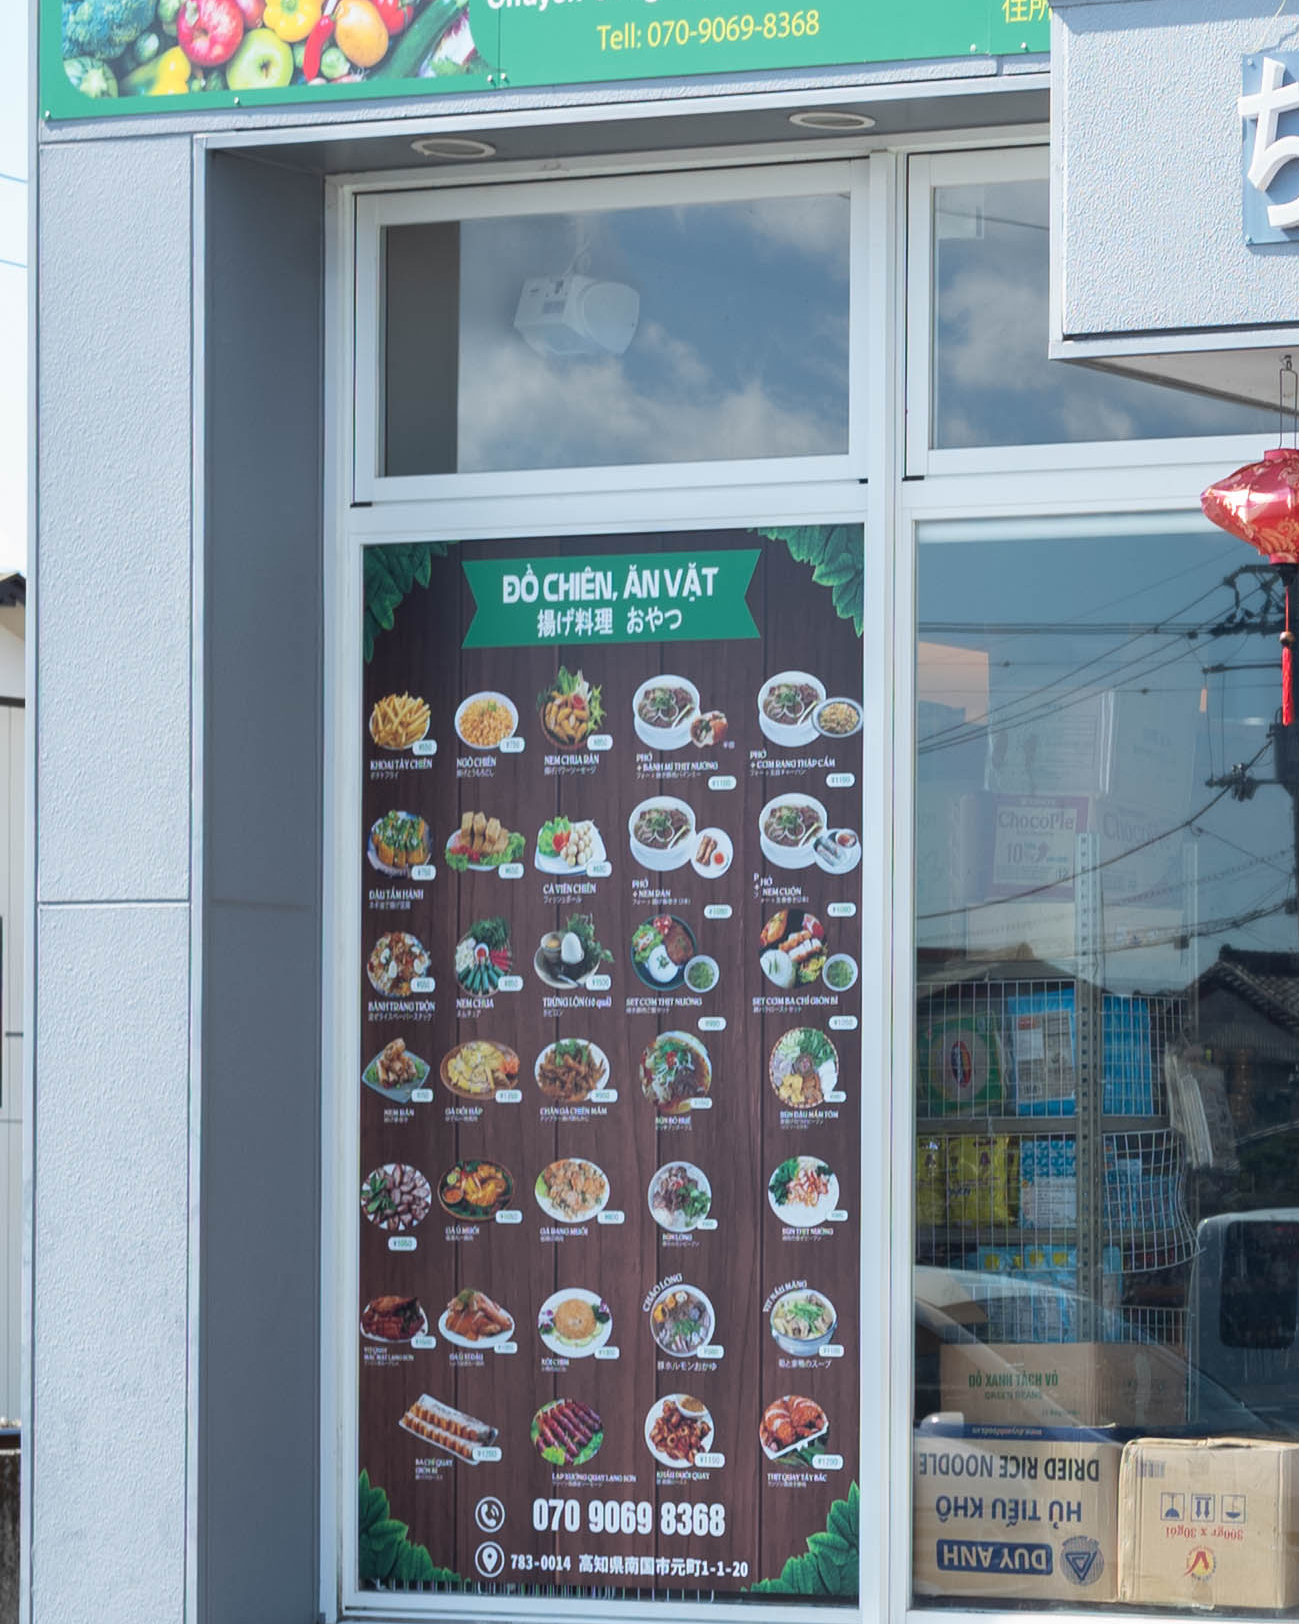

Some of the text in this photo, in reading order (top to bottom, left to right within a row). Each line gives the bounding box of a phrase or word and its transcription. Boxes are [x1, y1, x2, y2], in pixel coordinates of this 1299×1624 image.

[597, 9, 820, 51] Tell: 070-9069-8368
[503, 563, 539, 604] ĐỒ
[623, 564, 659, 600] ĂN
[537, 605, 682, 638] 揚げ料理 おやつ
[919, 1452, 1100, 1481] DRIED RICE NOODLE
[533, 1498, 726, 1537] 070 9069 8368
[935, 1495, 983, 1523] KHÔ
[511, 1553, 571, 1572] 783-0014
[942, 1545, 1047, 1570] DUY ANH
